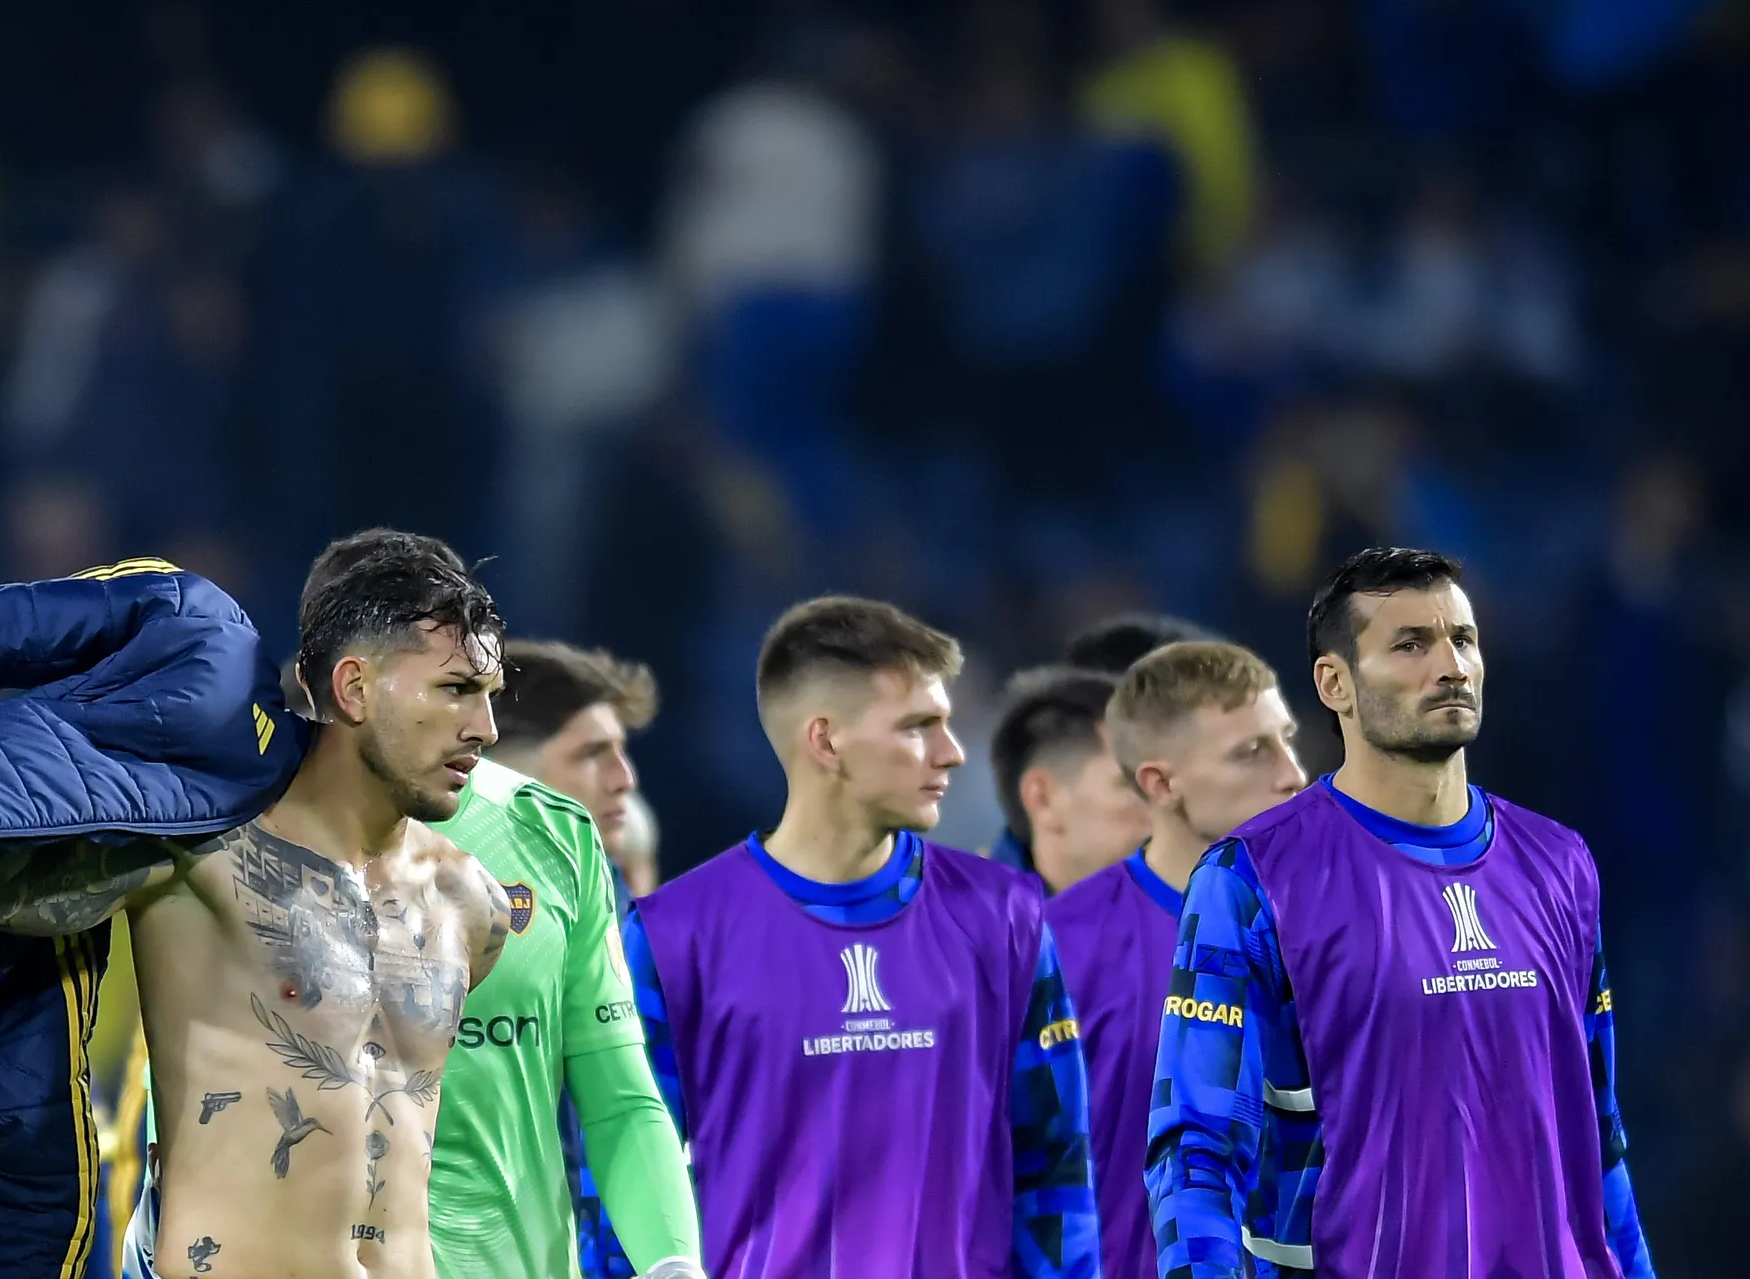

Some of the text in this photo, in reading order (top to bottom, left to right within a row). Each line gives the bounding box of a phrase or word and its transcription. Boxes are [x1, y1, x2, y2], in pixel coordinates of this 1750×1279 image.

[1456, 957, 1501, 972] CONMEBOL
[1422, 970, 1538, 995] LIBERTADORES
[802, 1031, 935, 1056] LIBERTADORES
